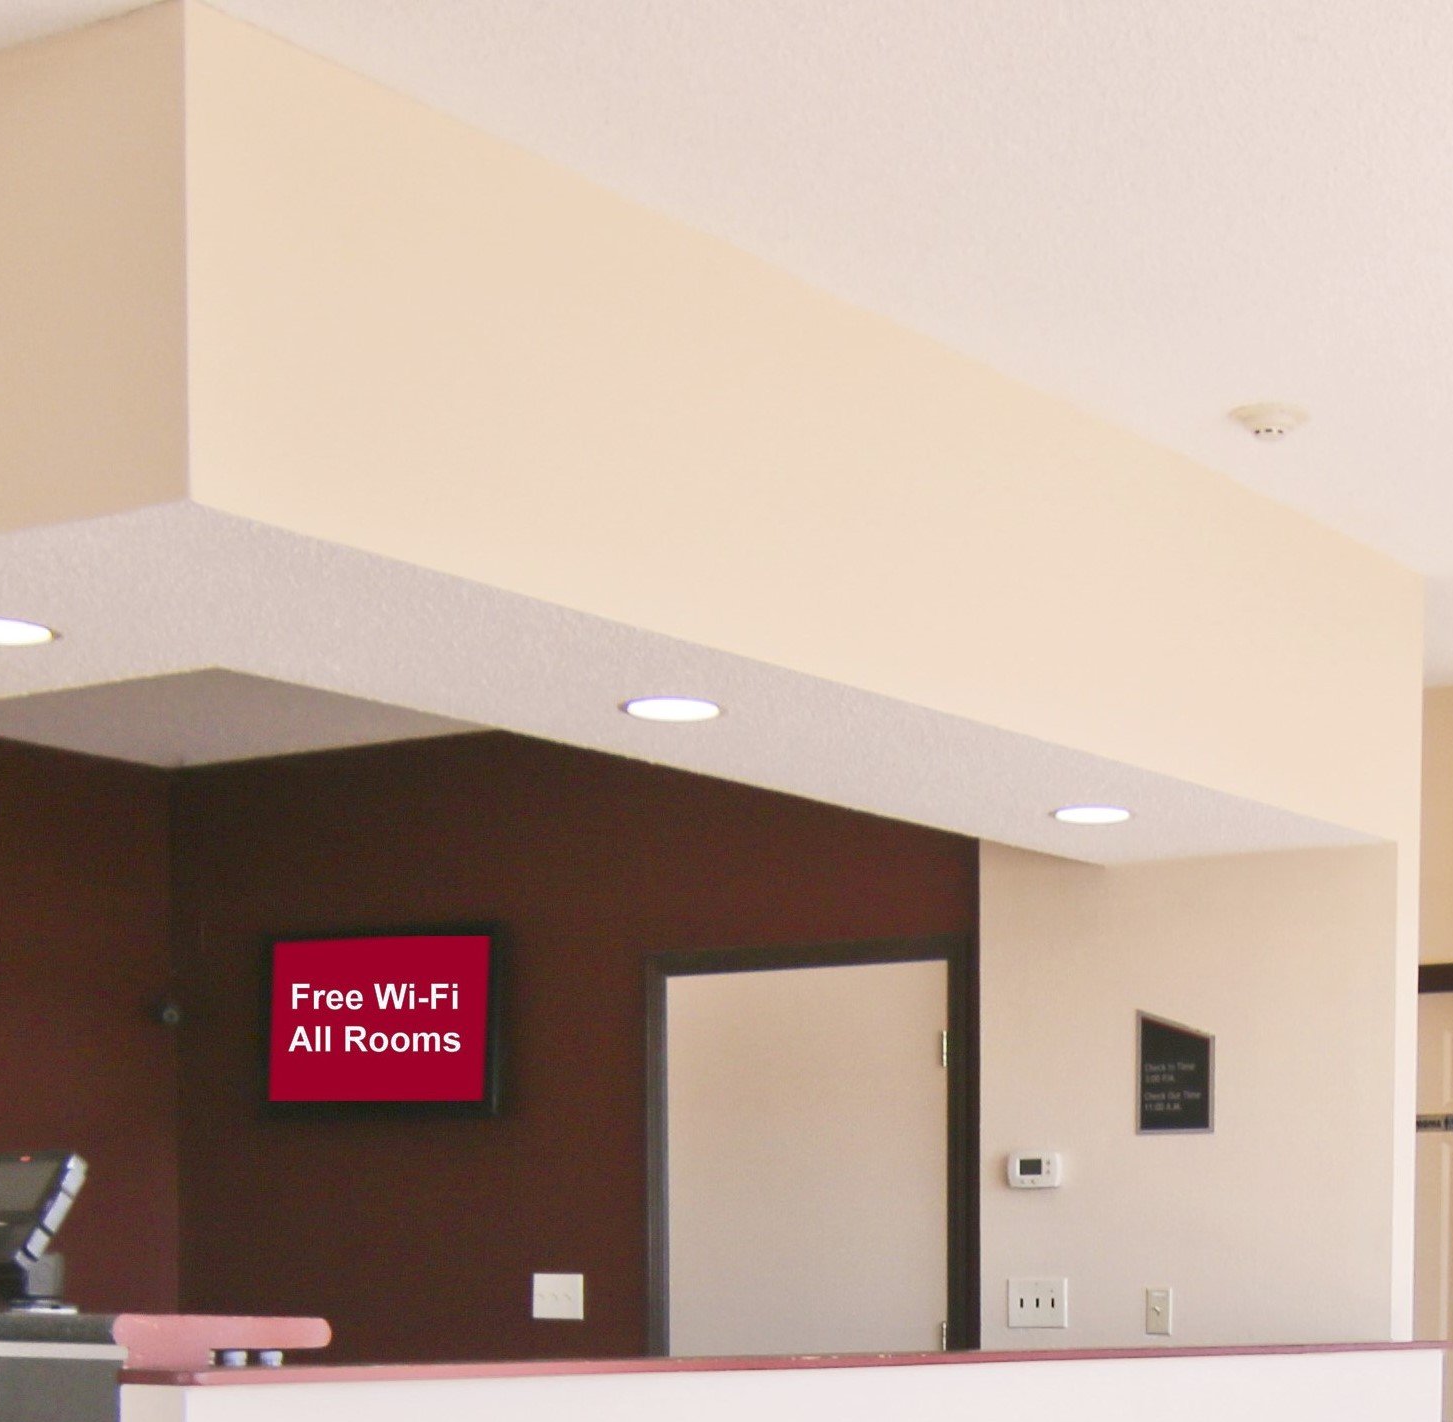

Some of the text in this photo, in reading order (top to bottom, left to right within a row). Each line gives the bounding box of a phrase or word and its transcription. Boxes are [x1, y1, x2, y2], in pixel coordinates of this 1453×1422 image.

[291, 983, 459, 1010] Free Wi-Fi
[288, 1025, 461, 1053] All Rooms
